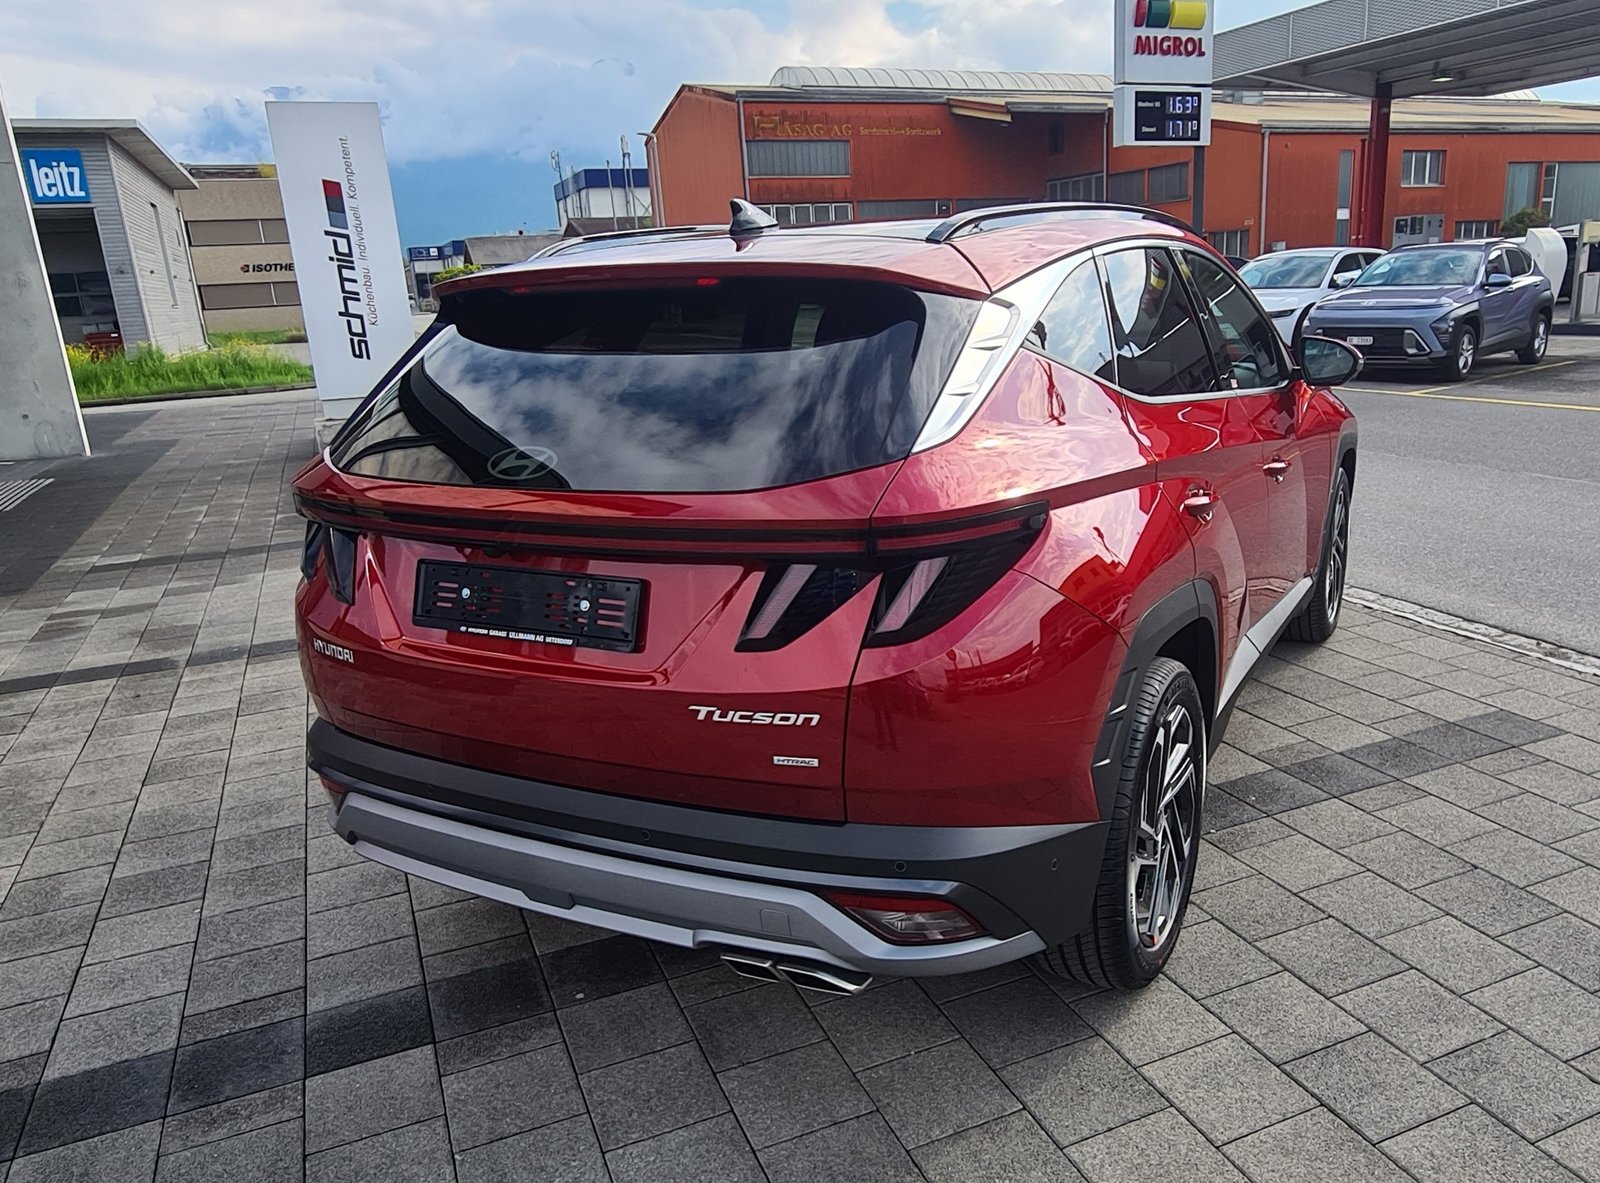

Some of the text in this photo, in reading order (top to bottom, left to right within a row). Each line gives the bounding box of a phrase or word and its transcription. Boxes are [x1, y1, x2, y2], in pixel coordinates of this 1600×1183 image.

[1133, 35, 1206, 57] MIGROL
[28, 158, 86, 197] leitz
[341, 135, 379, 327] Küchenbau. Individuell. Kompetent.
[323, 229, 371, 361] schmid
[313, 637, 355, 664] HYUNDAI
[776, 757, 815, 766] HTRAC
